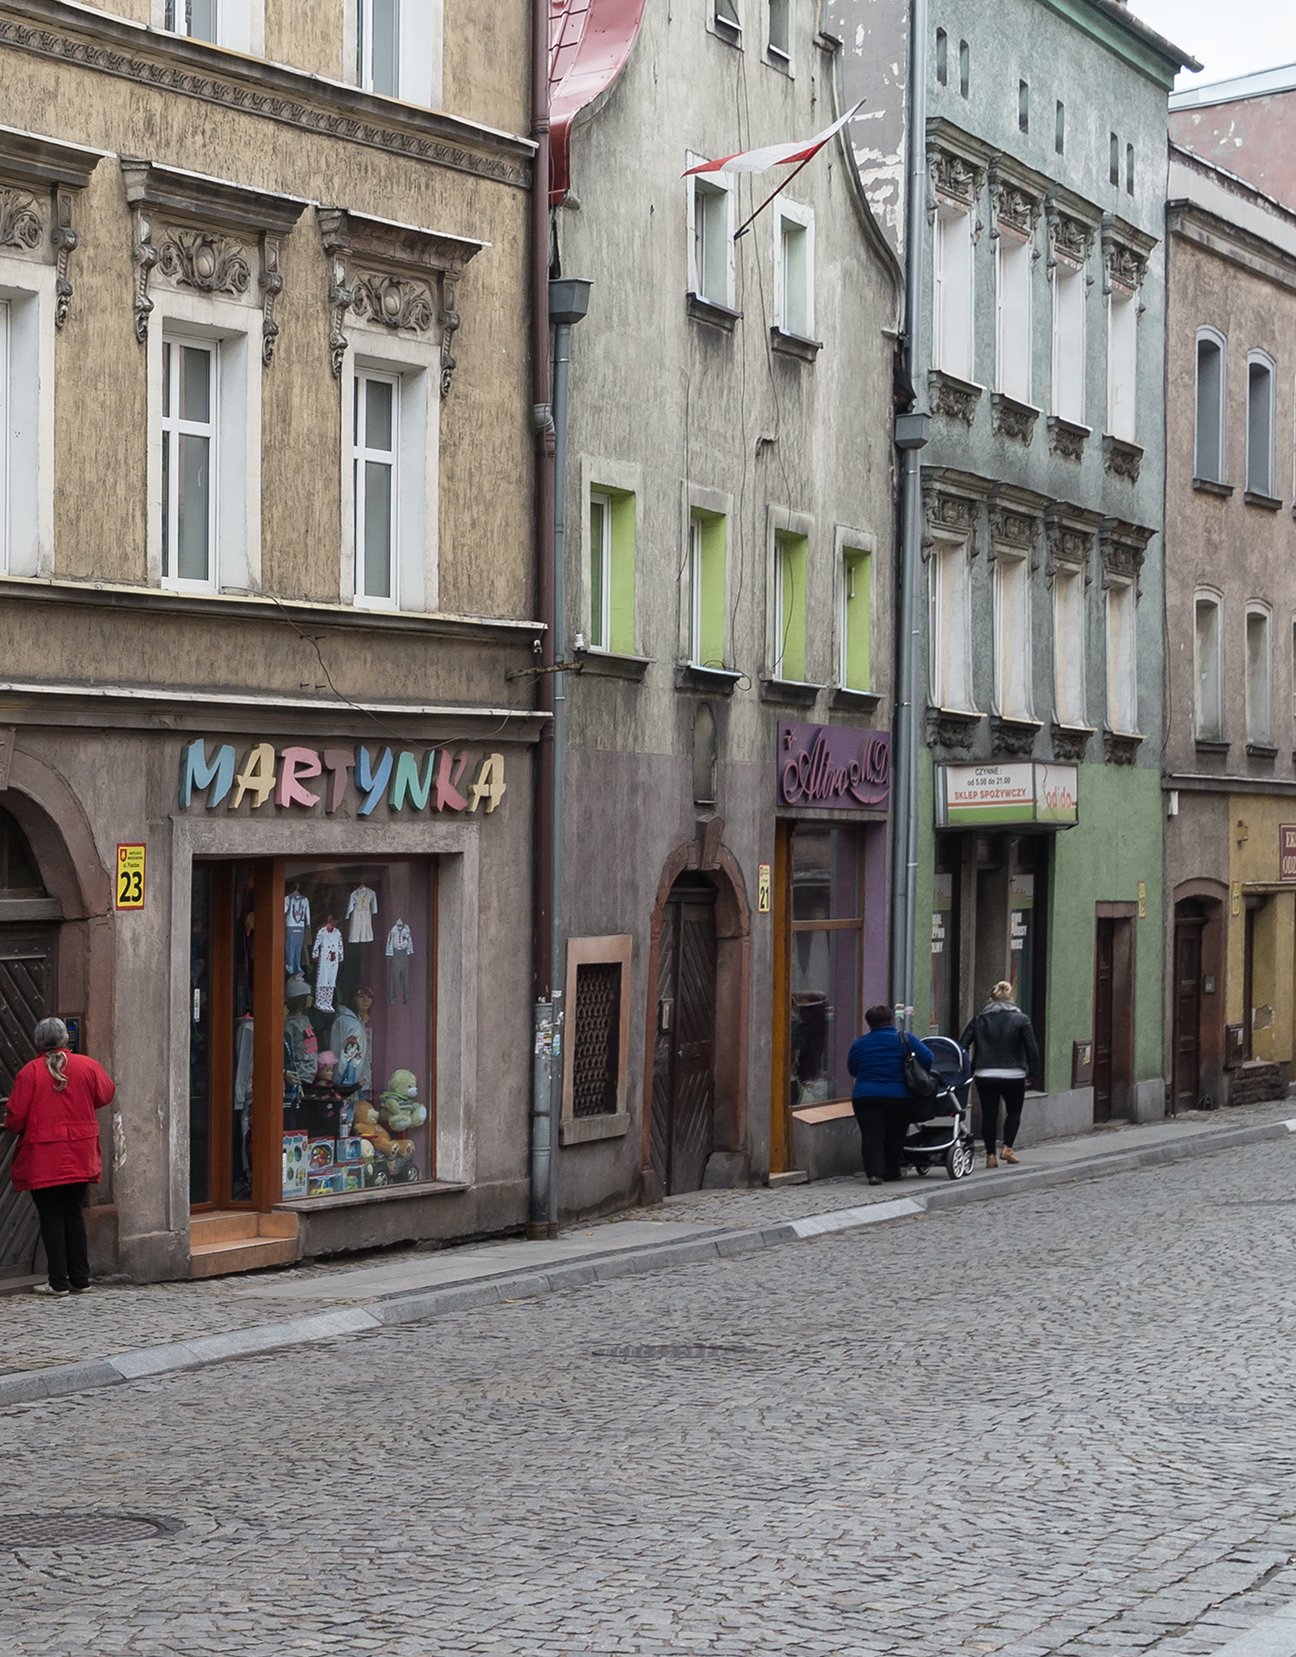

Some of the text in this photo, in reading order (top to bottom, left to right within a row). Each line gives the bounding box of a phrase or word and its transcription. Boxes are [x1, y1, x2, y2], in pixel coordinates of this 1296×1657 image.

[178, 738, 507, 816] MARTYNKA
[988, 777, 995, 785] do
[954, 788, 1027, 800] SKLEP SPOŻYWCZY
[119, 871, 143, 903] 23
[760, 886, 769, 909] 21
